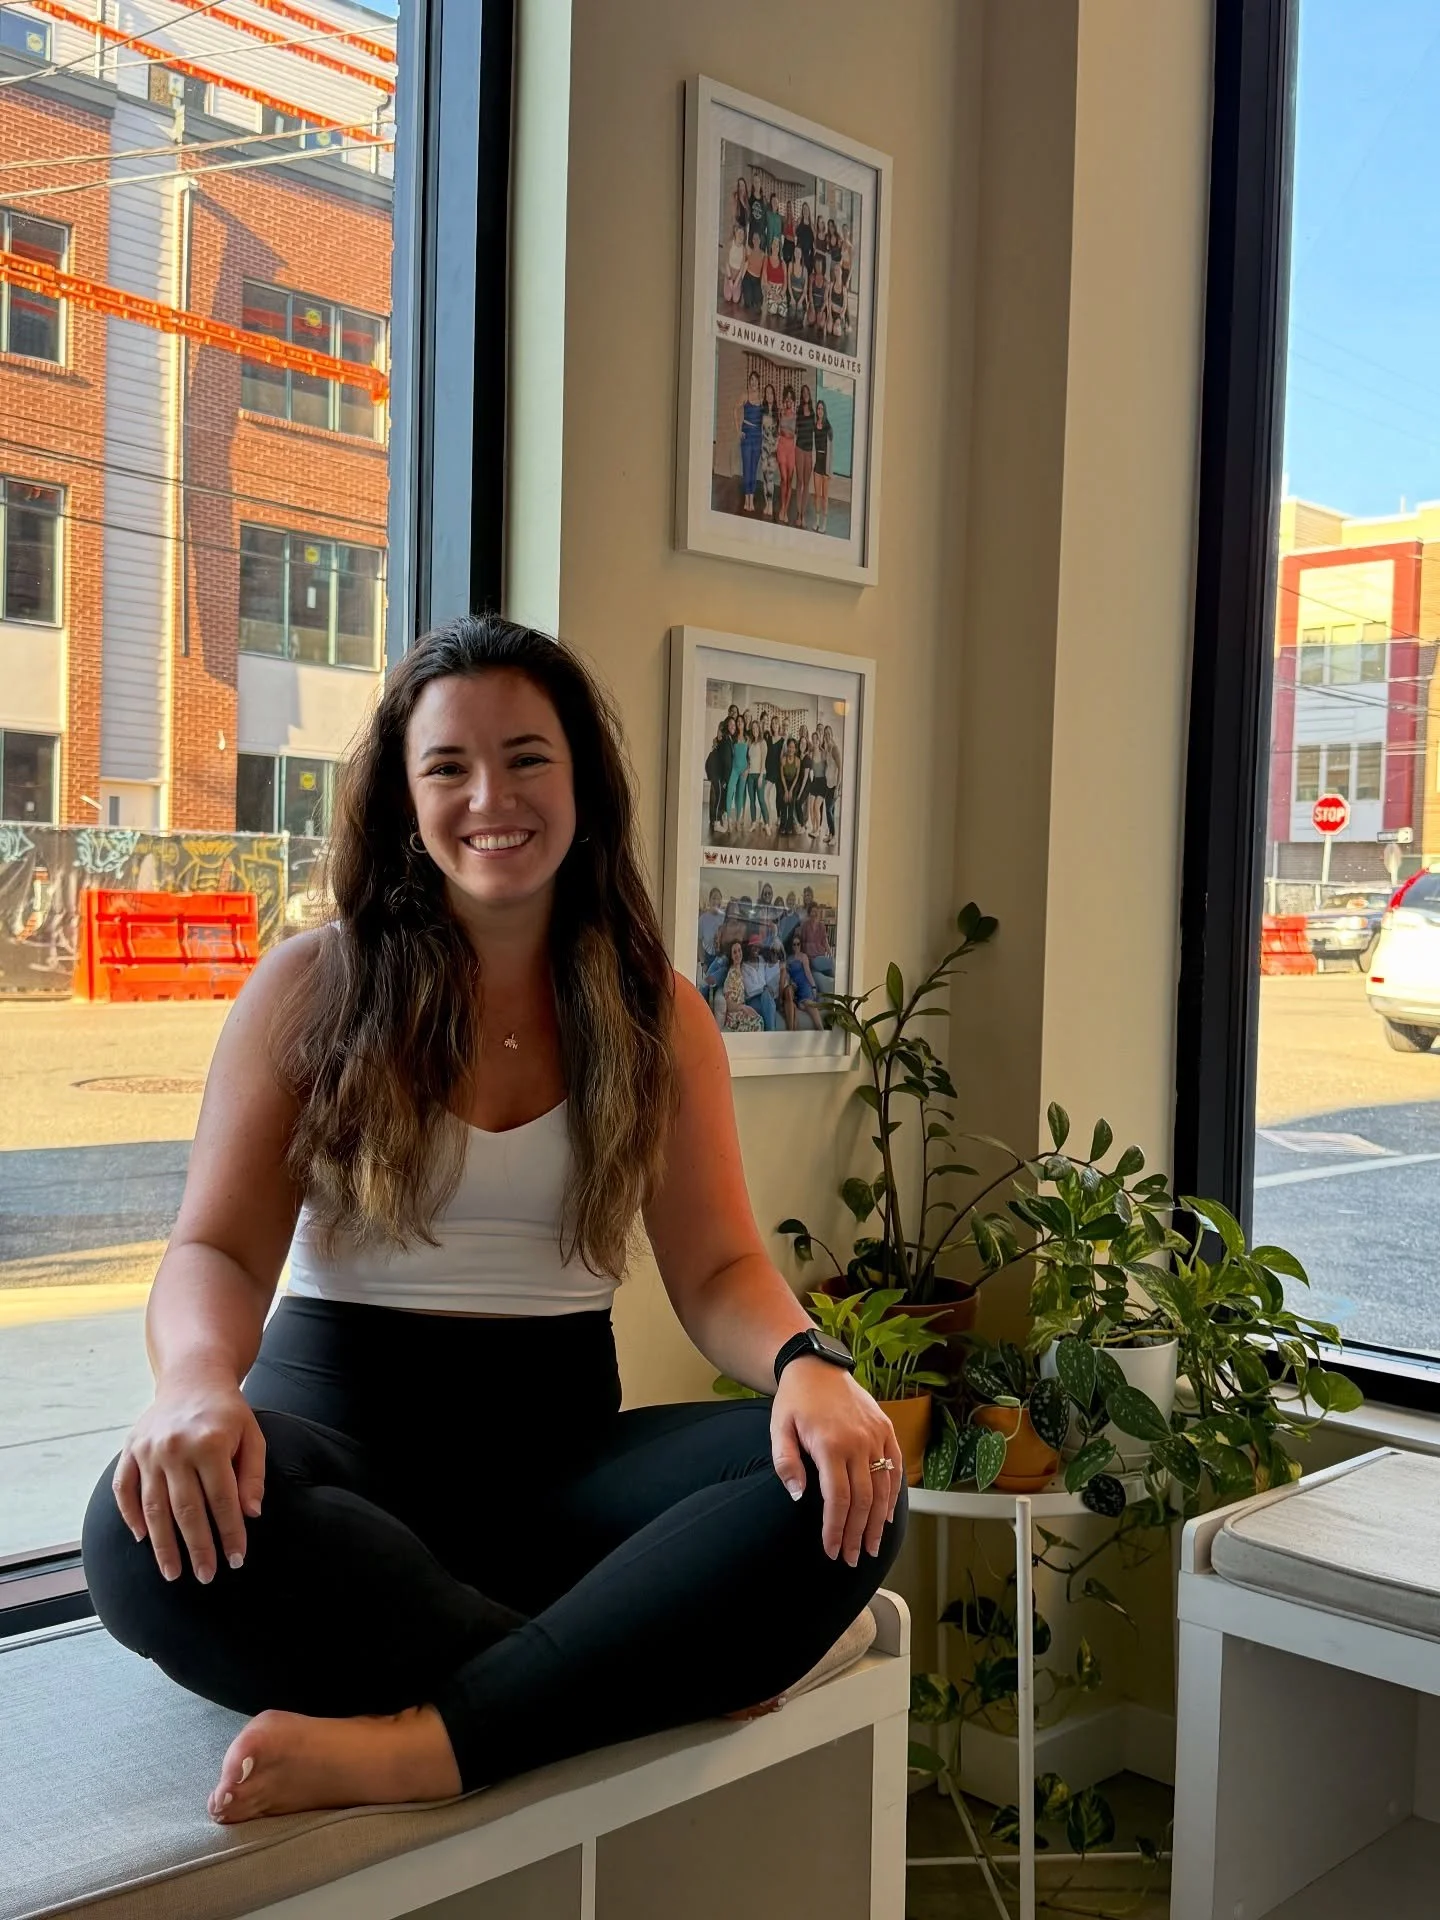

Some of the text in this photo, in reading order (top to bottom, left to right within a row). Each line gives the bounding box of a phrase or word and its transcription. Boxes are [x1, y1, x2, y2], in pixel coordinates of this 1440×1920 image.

[732, 325, 861, 374] JANUARY 2024 GRADUATES
[1315, 807, 1345, 822] STOP
[720, 853, 827, 870] MAY 2024 GRADUATES
